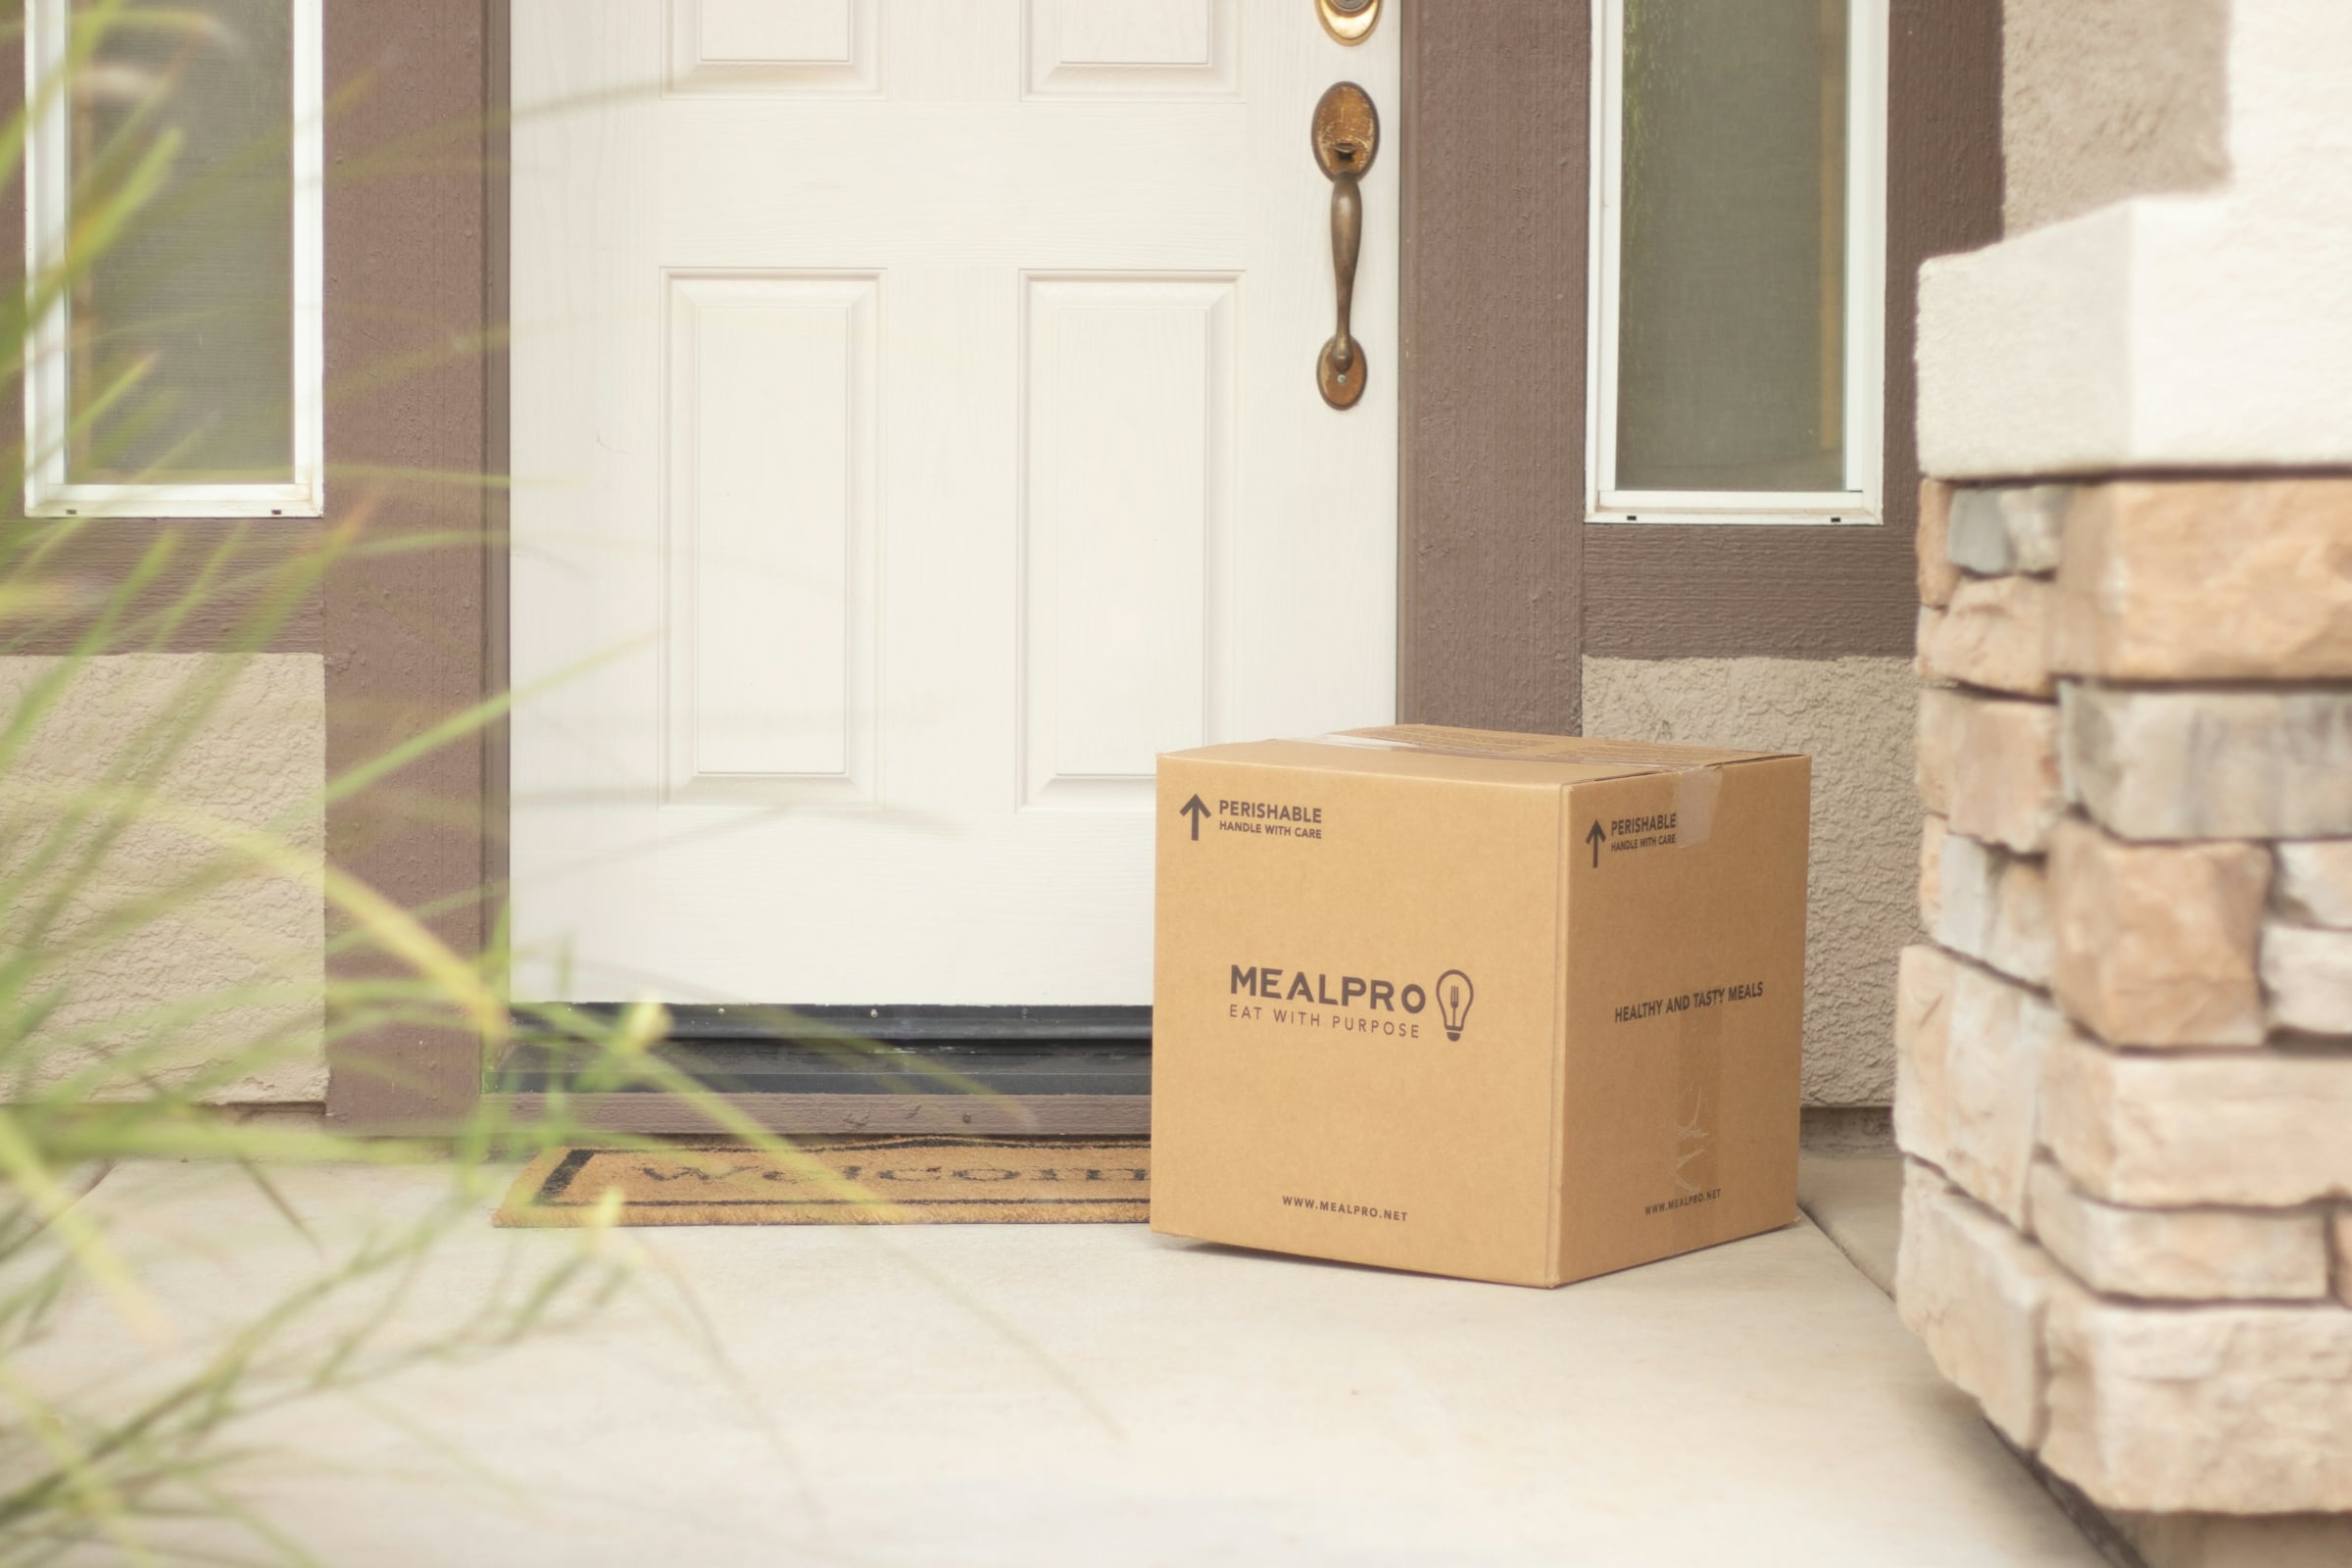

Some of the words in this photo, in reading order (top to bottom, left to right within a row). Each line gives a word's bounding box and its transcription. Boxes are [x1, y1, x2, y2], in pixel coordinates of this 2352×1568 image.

[1219, 800, 1322, 823] PERISHABLE
[1219, 820, 1261, 833] HANDLE
[1264, 824, 1292, 836] WITH
[1295, 827, 1322, 839] CARE
[1611, 813, 1677, 836] PERISHABLE
[1611, 839, 1639, 853] HANDLE
[1640, 836, 1657, 848] WITH
[1658, 834, 1676, 846] CARE
[1231, 964, 1426, 1014] MEALPRO
[1615, 1000, 1663, 1023] HEALTHY
[1666, 995, 1690, 1014] AND
[1693, 988, 1725, 1007] TASTY
[1728, 982, 1763, 1002] MEALS
[1230, 1004, 1262, 1020] EAT
[1273, 1008, 1320, 1027] WITH
[1333, 1015, 1419, 1039] PURPOSE
[631, 1165, 1151, 1183] Welcom
[1282, 1196, 1408, 1221] WWW.MEALPRO.NET
[1645, 1189, 1722, 1215] WWW.MEALPRO.NET
